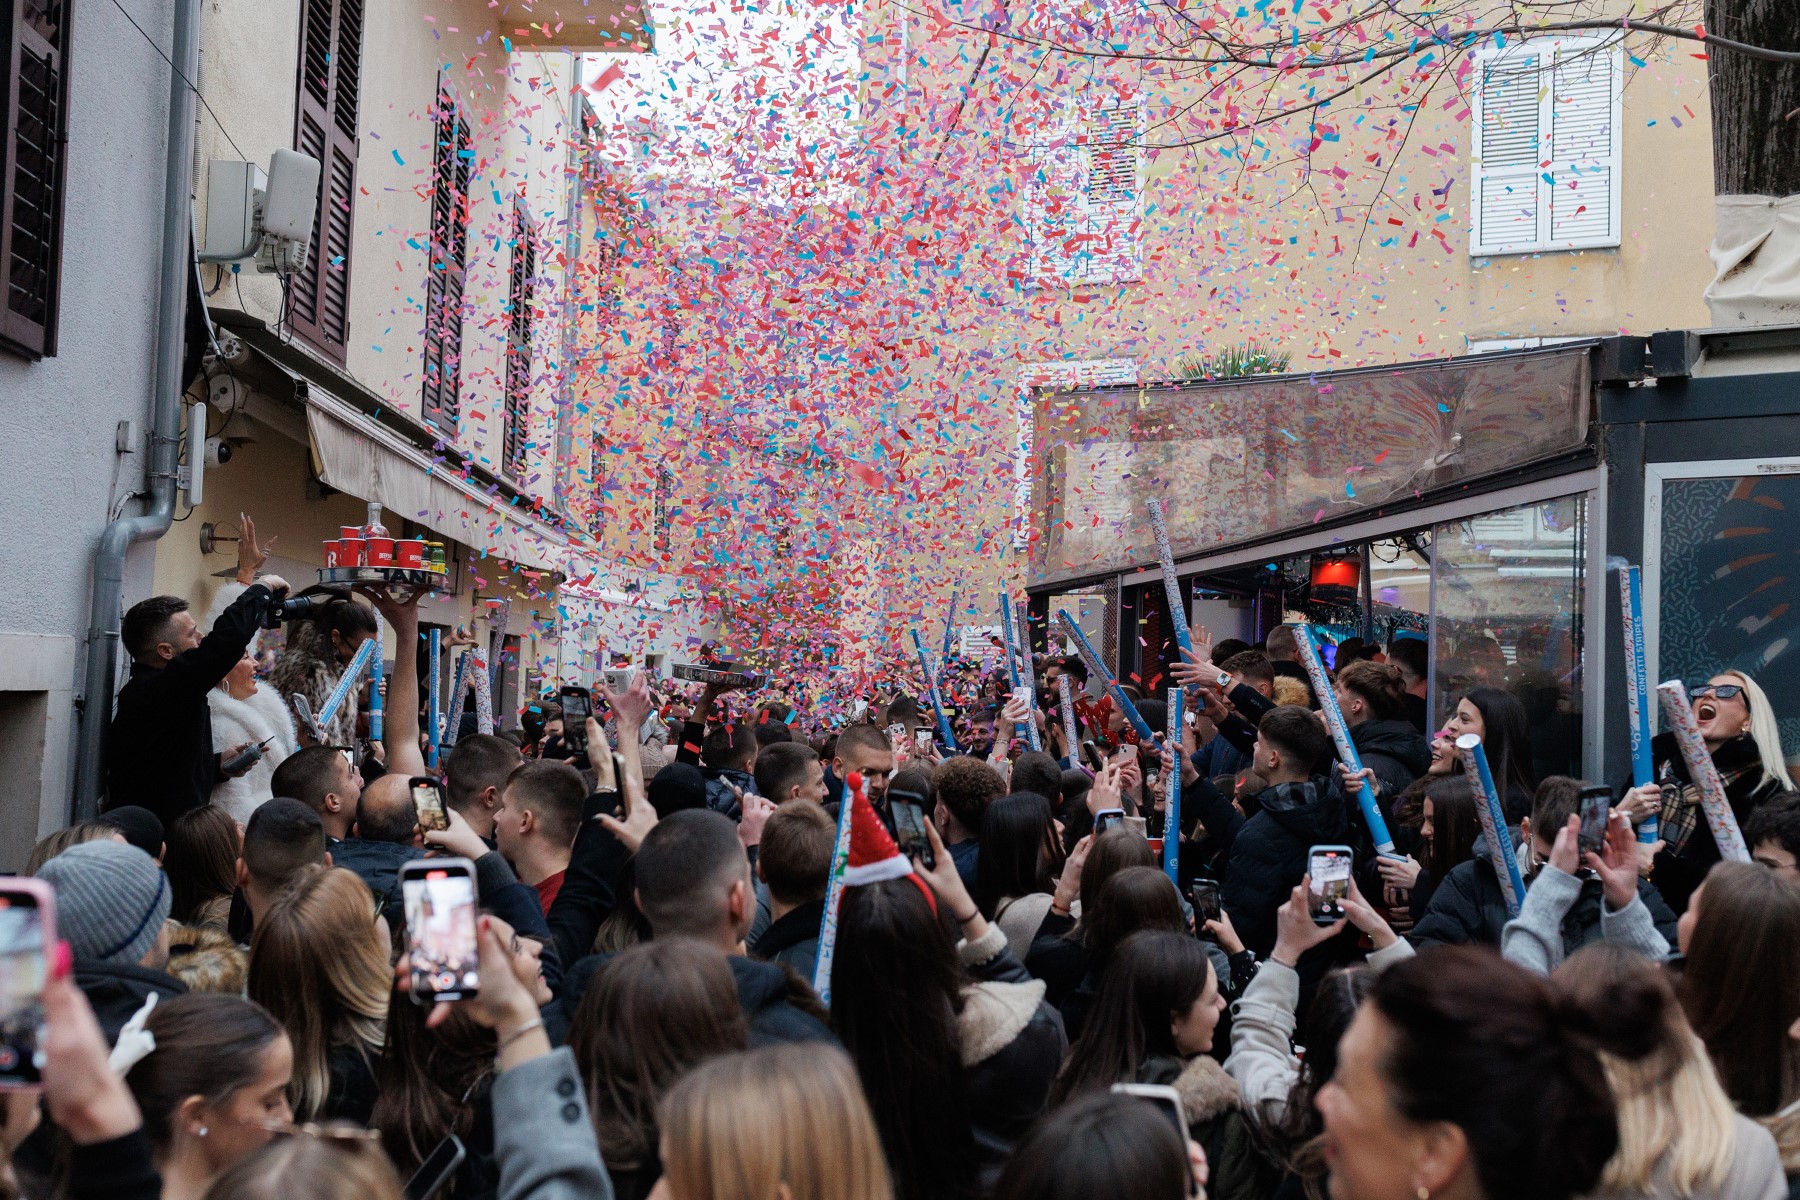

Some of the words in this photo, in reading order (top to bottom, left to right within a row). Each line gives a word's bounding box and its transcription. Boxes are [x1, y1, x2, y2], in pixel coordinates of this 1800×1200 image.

[1634, 615, 1643, 652] STRIPES
[1319, 664, 1334, 696] STRIPES
[1637, 655, 1646, 695] CONFETTI
[1332, 697, 1347, 731] CONFETTI
[1488, 790, 1504, 827] STRIPES
[1500, 829, 1516, 868] CONFETTI
